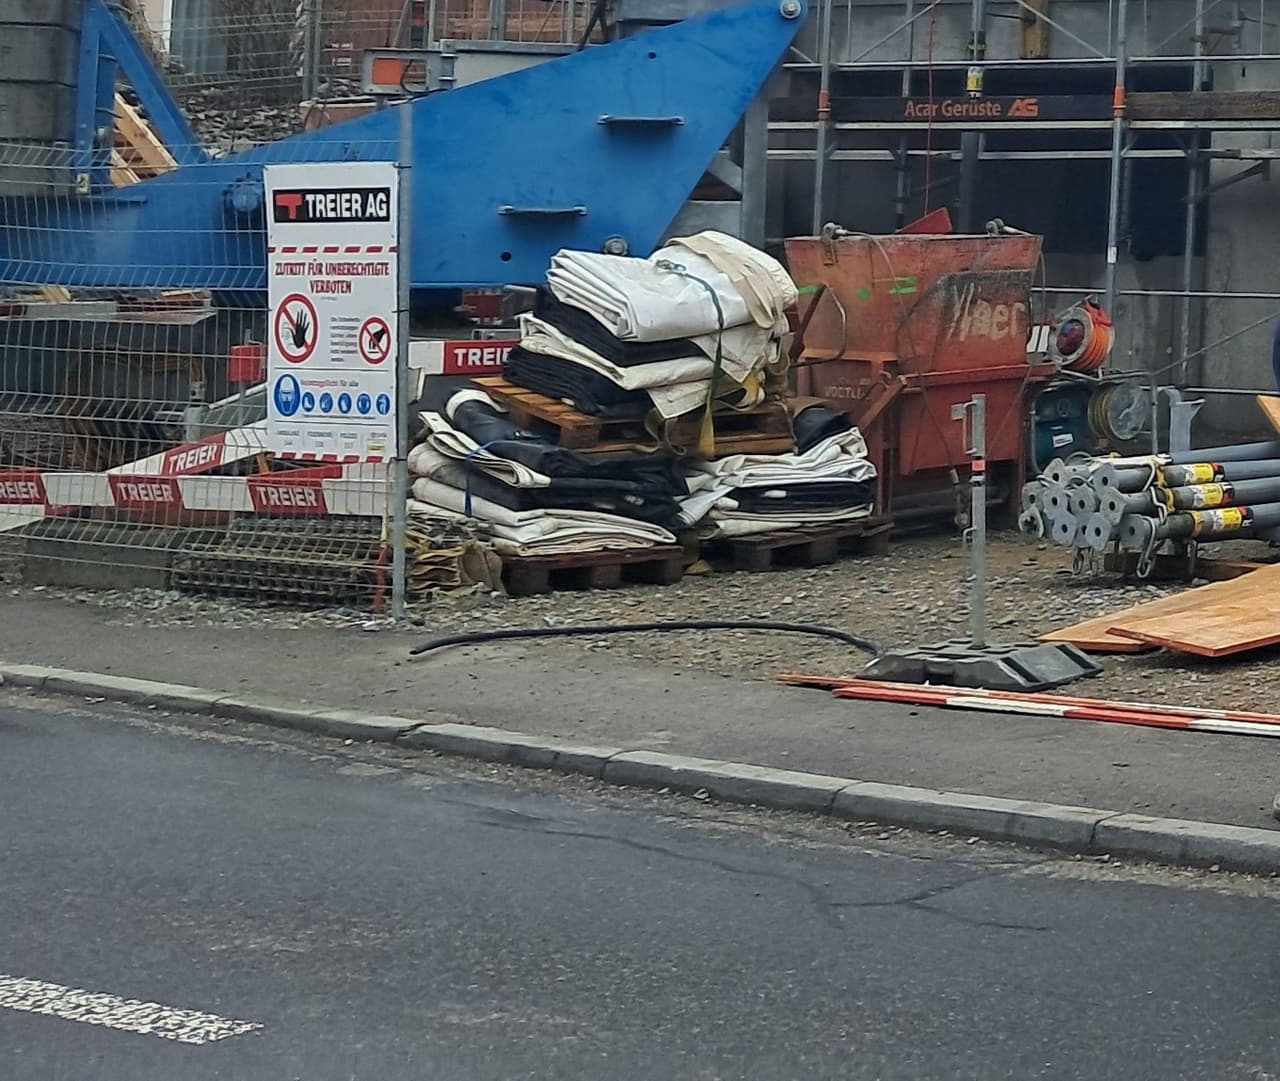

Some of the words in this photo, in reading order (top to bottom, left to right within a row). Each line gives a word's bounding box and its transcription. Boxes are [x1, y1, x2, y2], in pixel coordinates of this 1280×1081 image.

[905, 100, 938, 116] Acar
[942, 100, 1001, 116] Gerüste
[1008, 98, 1039, 116] AG
[305, 192, 363, 219] TREIER
[365, 192, 388, 218] AG
[454, 347, 512, 366] TREI
[168, 444, 217, 474] TREIER
[116, 482, 174, 503] TREIER
[256, 486, 318, 507] TREIER
